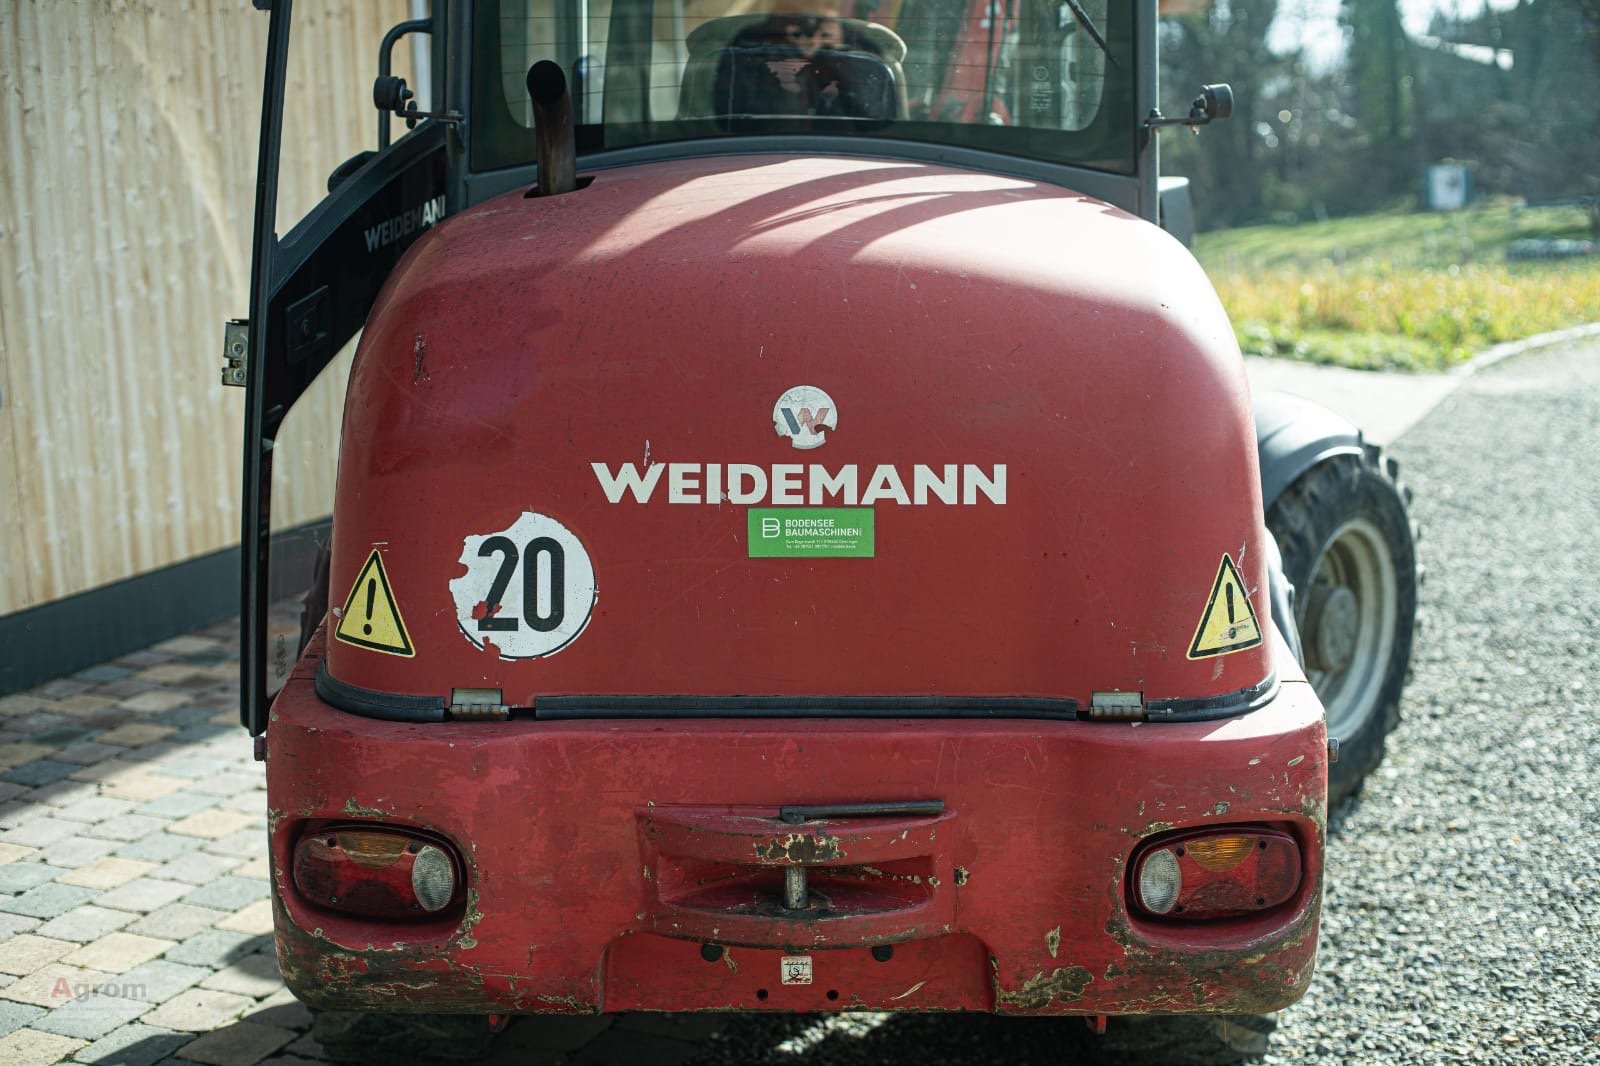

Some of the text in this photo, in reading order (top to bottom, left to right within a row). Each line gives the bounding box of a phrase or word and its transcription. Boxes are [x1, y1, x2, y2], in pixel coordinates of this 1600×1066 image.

[591, 463, 1007, 505] WEIDEMANN
[785, 519, 835, 528] BODENSEE
[785, 528, 859, 537] BAUMASCHINEN
[477, 536, 566, 632] 20
